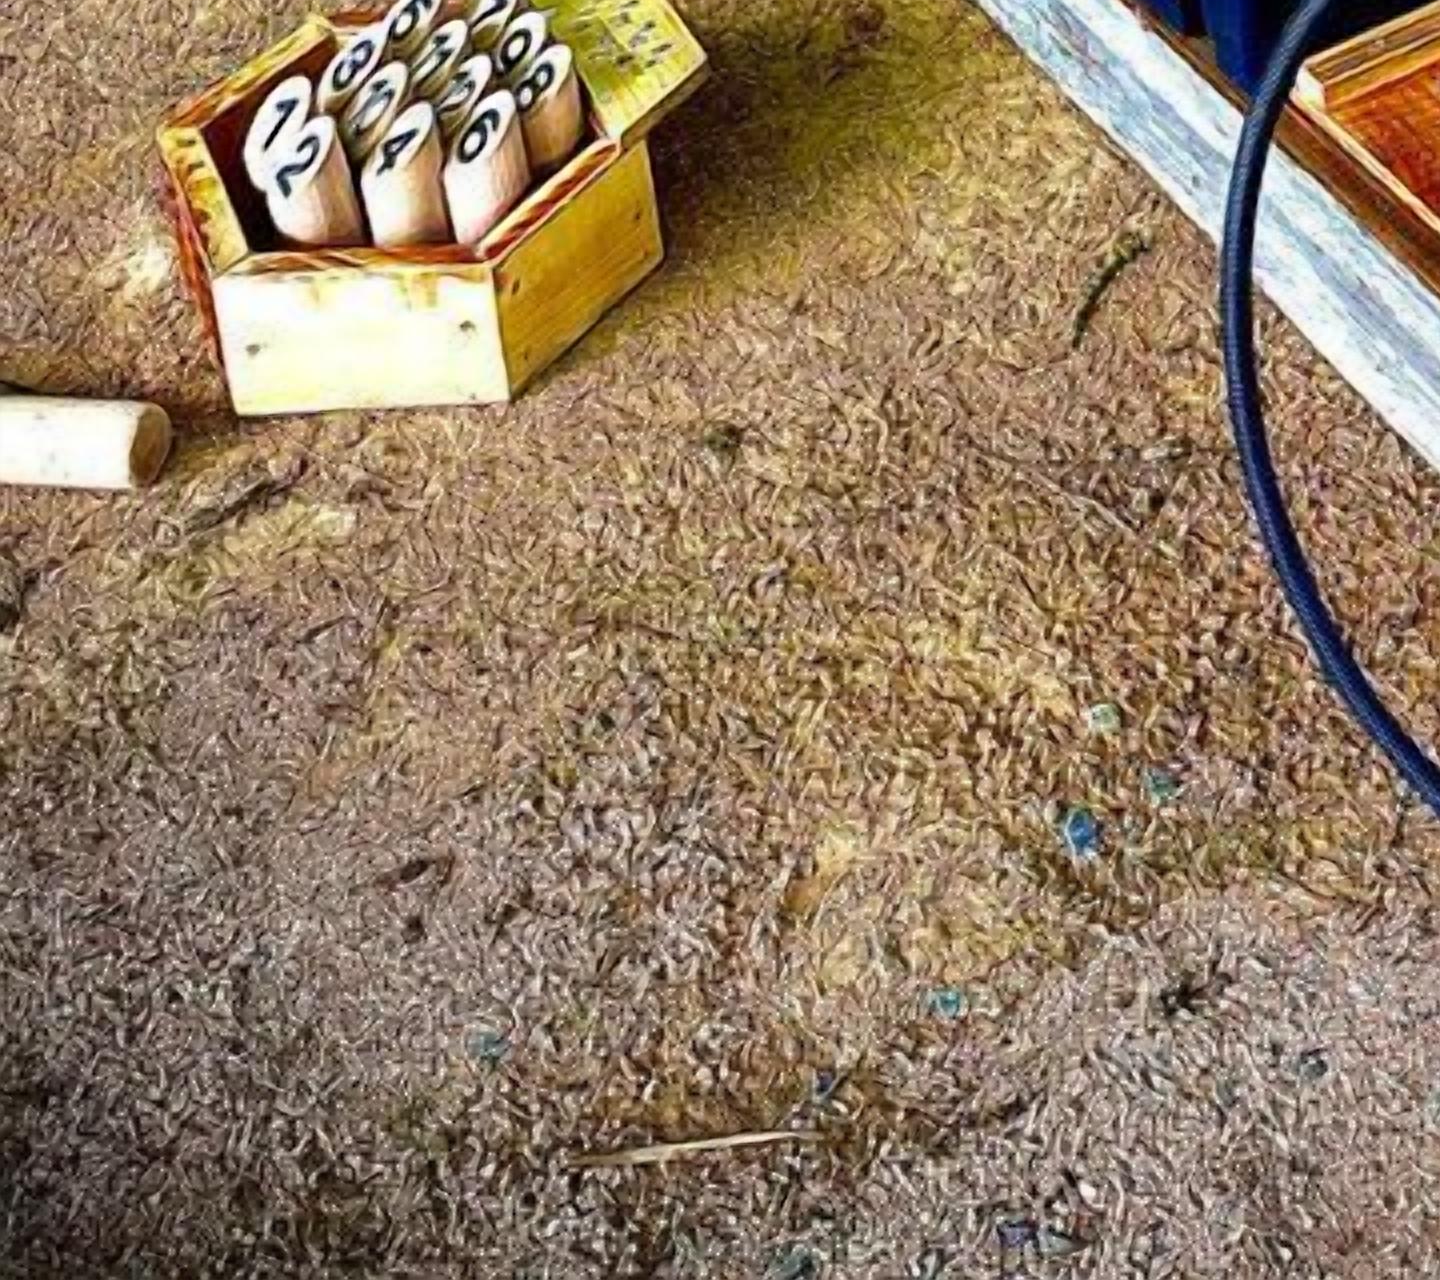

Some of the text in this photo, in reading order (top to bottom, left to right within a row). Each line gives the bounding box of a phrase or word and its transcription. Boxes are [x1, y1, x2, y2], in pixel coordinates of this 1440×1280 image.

[263, 98, 300, 151] 1
[457, 108, 500, 163] 6
[276, 136, 320, 197] 2
[376, 128, 419, 176] 4
